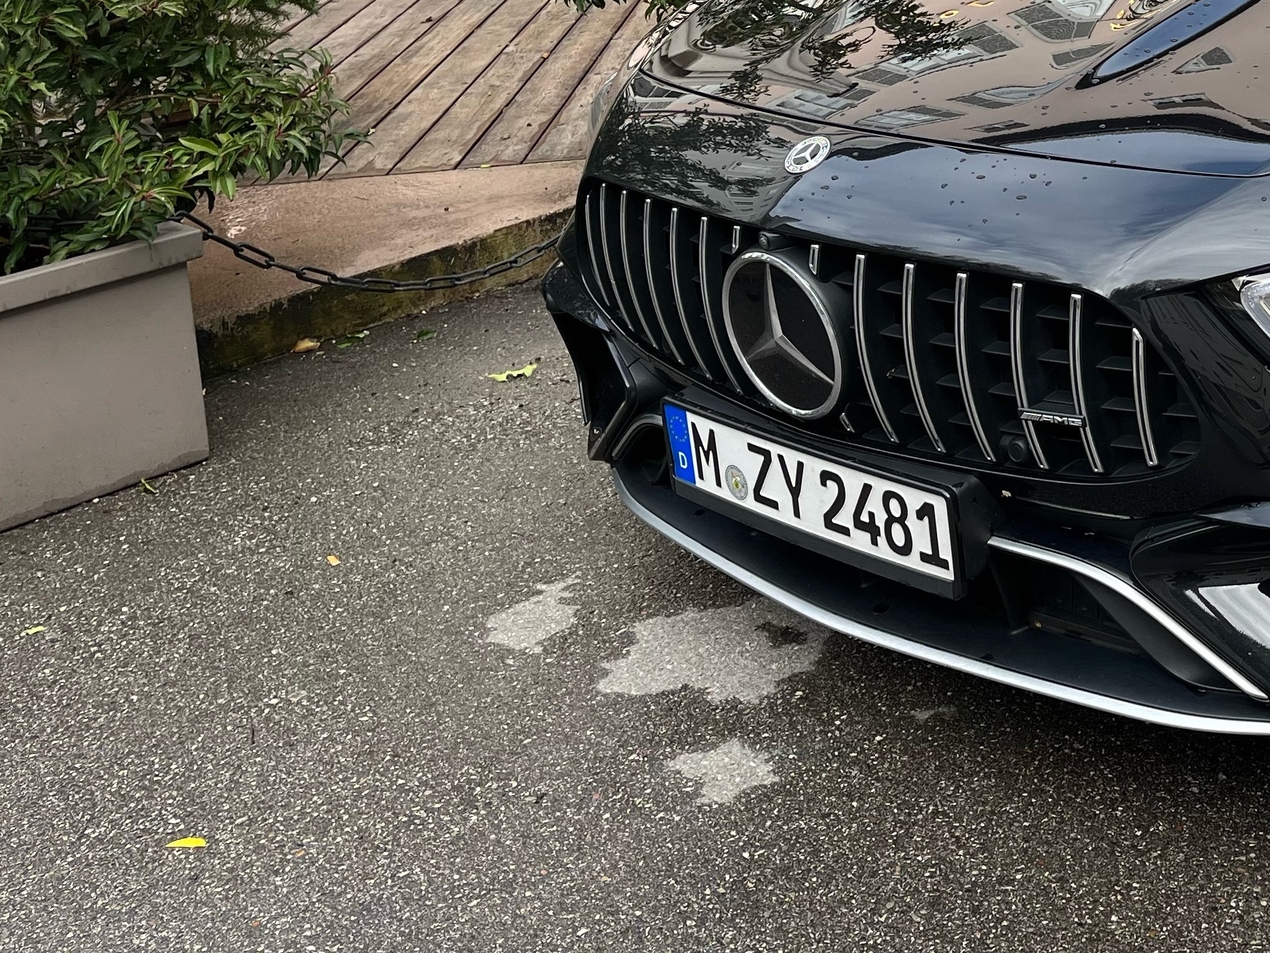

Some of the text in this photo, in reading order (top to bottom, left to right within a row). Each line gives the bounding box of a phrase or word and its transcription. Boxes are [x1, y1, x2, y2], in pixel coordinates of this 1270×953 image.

[1040, 413, 1083, 427] AMG
[678, 451, 688, 470] D
[690, 421, 723, 489] M
[746, 441, 805, 520] ZY
[819, 469, 951, 572] 2481
